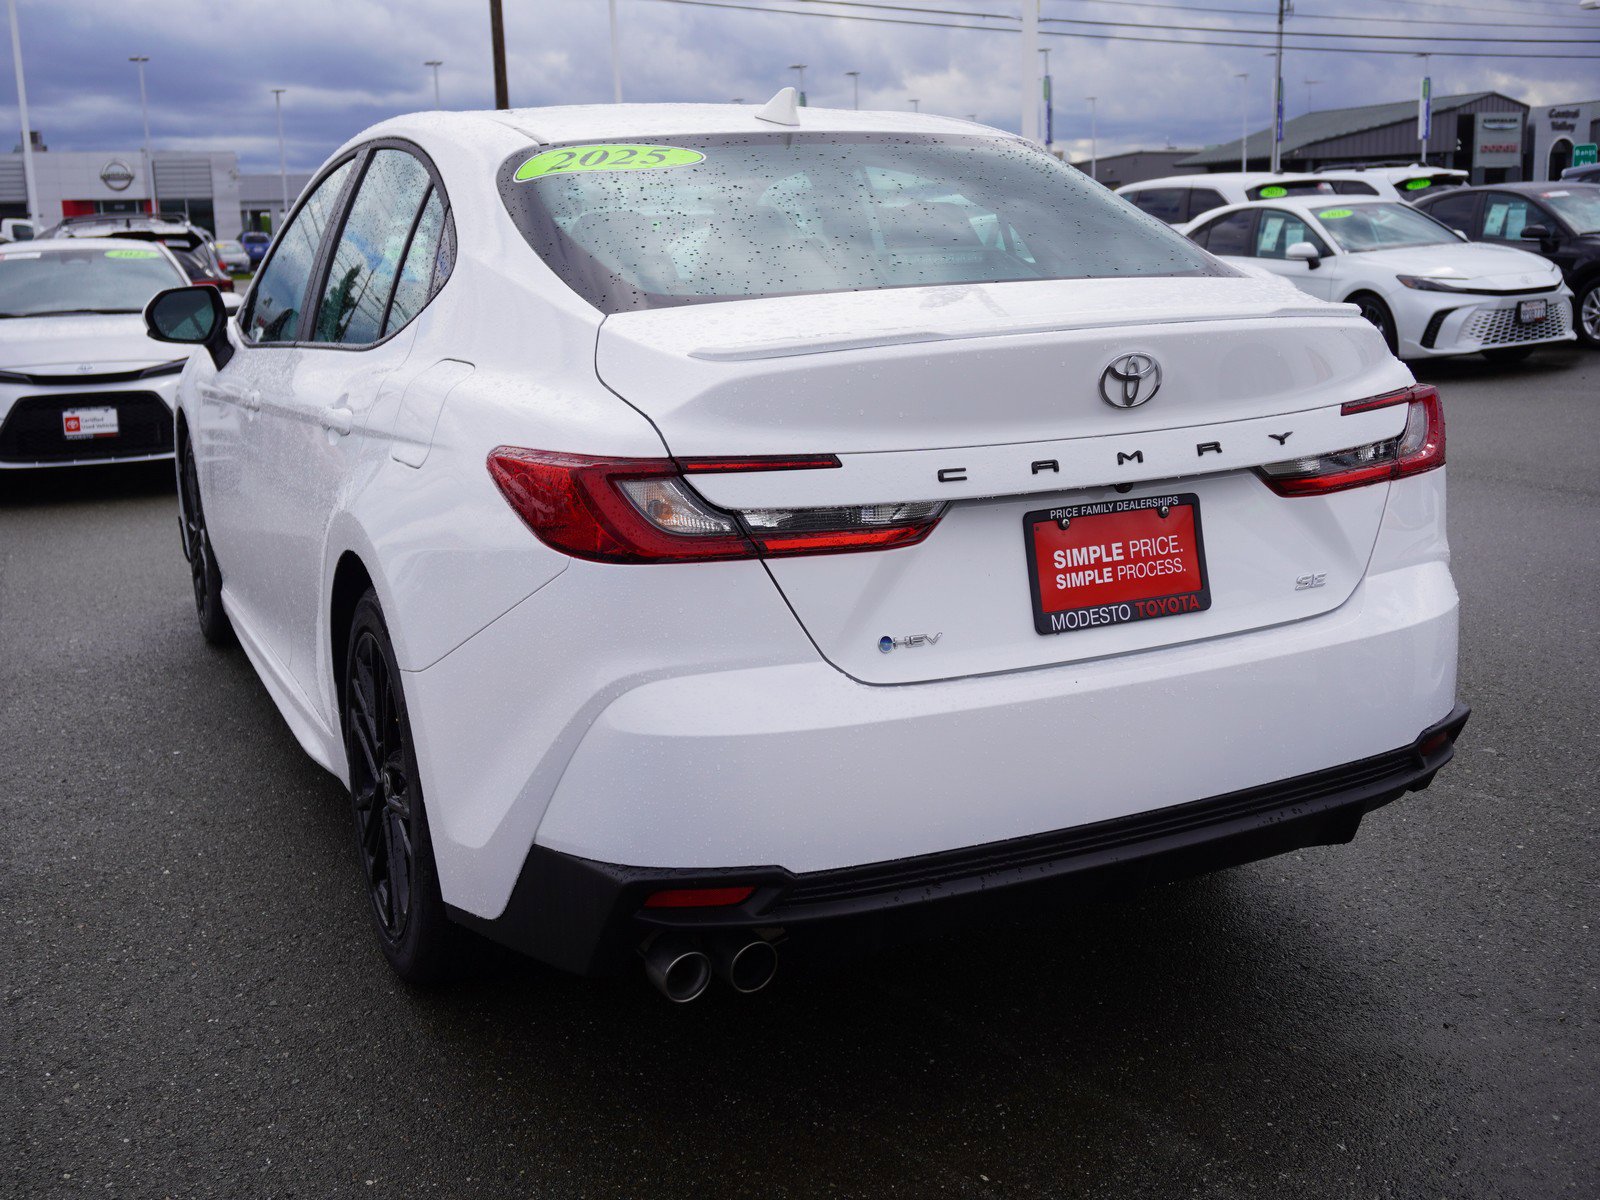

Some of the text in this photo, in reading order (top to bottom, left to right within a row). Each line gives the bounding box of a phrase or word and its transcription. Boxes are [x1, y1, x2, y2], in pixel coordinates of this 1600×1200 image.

[544, 149, 672, 173] 2025
[936, 430, 1294, 483] CAMRY
[1050, 496, 1179, 520] PRICE FAMILY DEALERSHIPS
[1053, 535, 1184, 569] SIMPLE PRICE.
[1056, 557, 1186, 590] SIMPLE PROCESS.
[1294, 572, 1327, 592] SE
[1051, 595, 1201, 631] MODESTO TOYOTA
